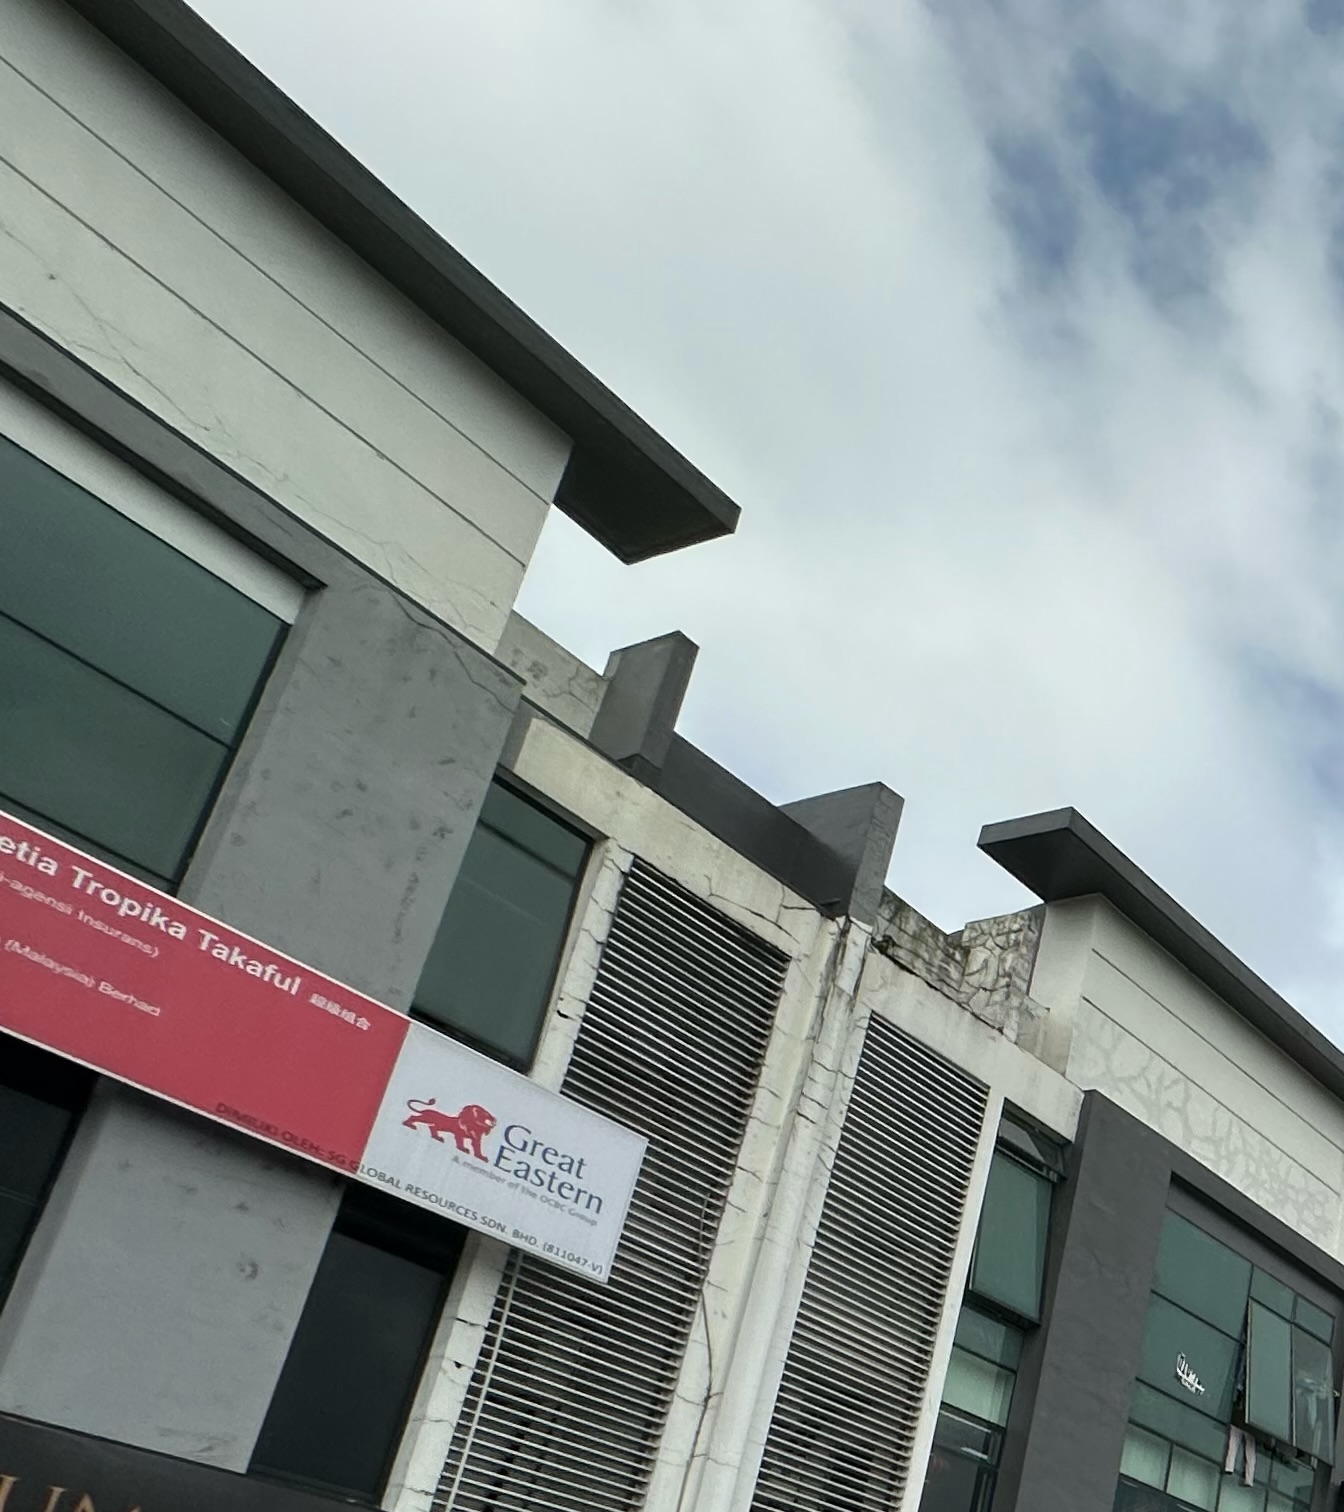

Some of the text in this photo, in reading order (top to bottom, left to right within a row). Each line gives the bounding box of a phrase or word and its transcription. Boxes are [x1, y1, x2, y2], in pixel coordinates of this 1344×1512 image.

[71, 865, 188, 940] Tropika
[198, 929, 301, 995] Takaful
[463, 1160, 506, 1184] member
[493, 1145, 604, 1215] Eastern
[504, 1124, 588, 1179] Great
[350, 1159, 402, 1190] GLOBAL
[405, 1183, 478, 1222] RESOURCES
[480, 1215, 508, 1234] SDN.
[511, 1228, 540, 1247] BHD.
